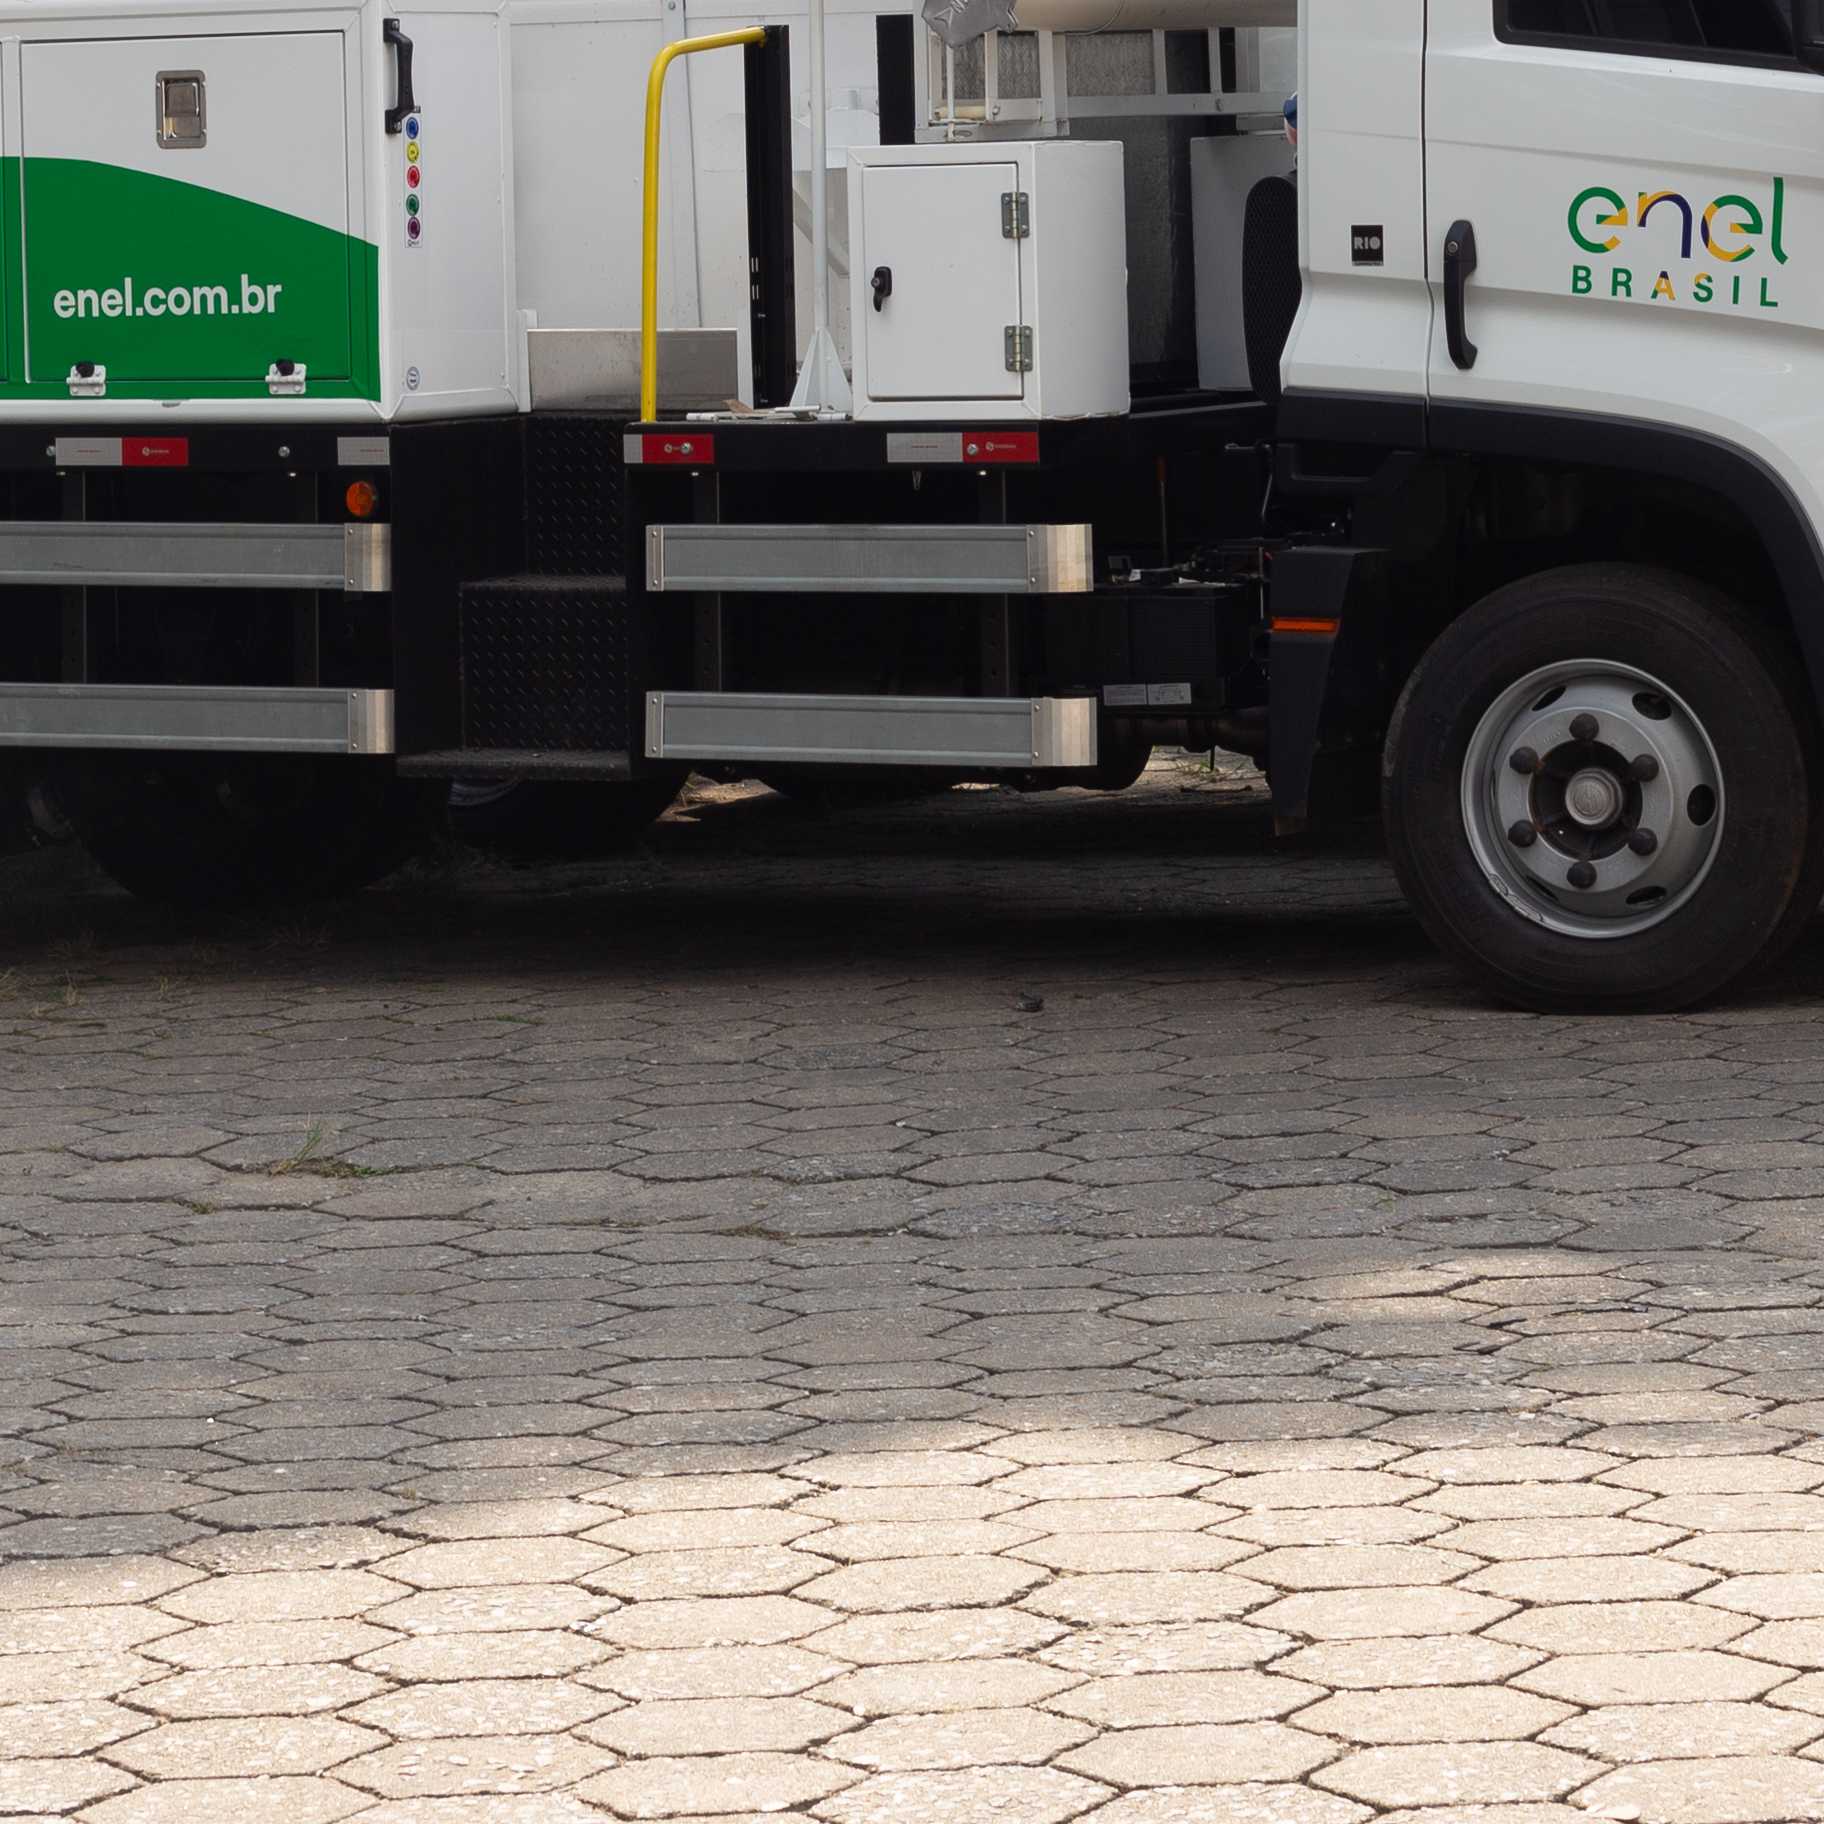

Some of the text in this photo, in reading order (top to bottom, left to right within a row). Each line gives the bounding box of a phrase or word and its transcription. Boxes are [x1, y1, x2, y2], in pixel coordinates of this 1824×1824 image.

[1354, 236, 1381, 250] RIO
[1567, 176, 1788, 266] enel
[53, 273, 282, 318] enel.com.br
[1572, 265, 1779, 308] BRASIL
